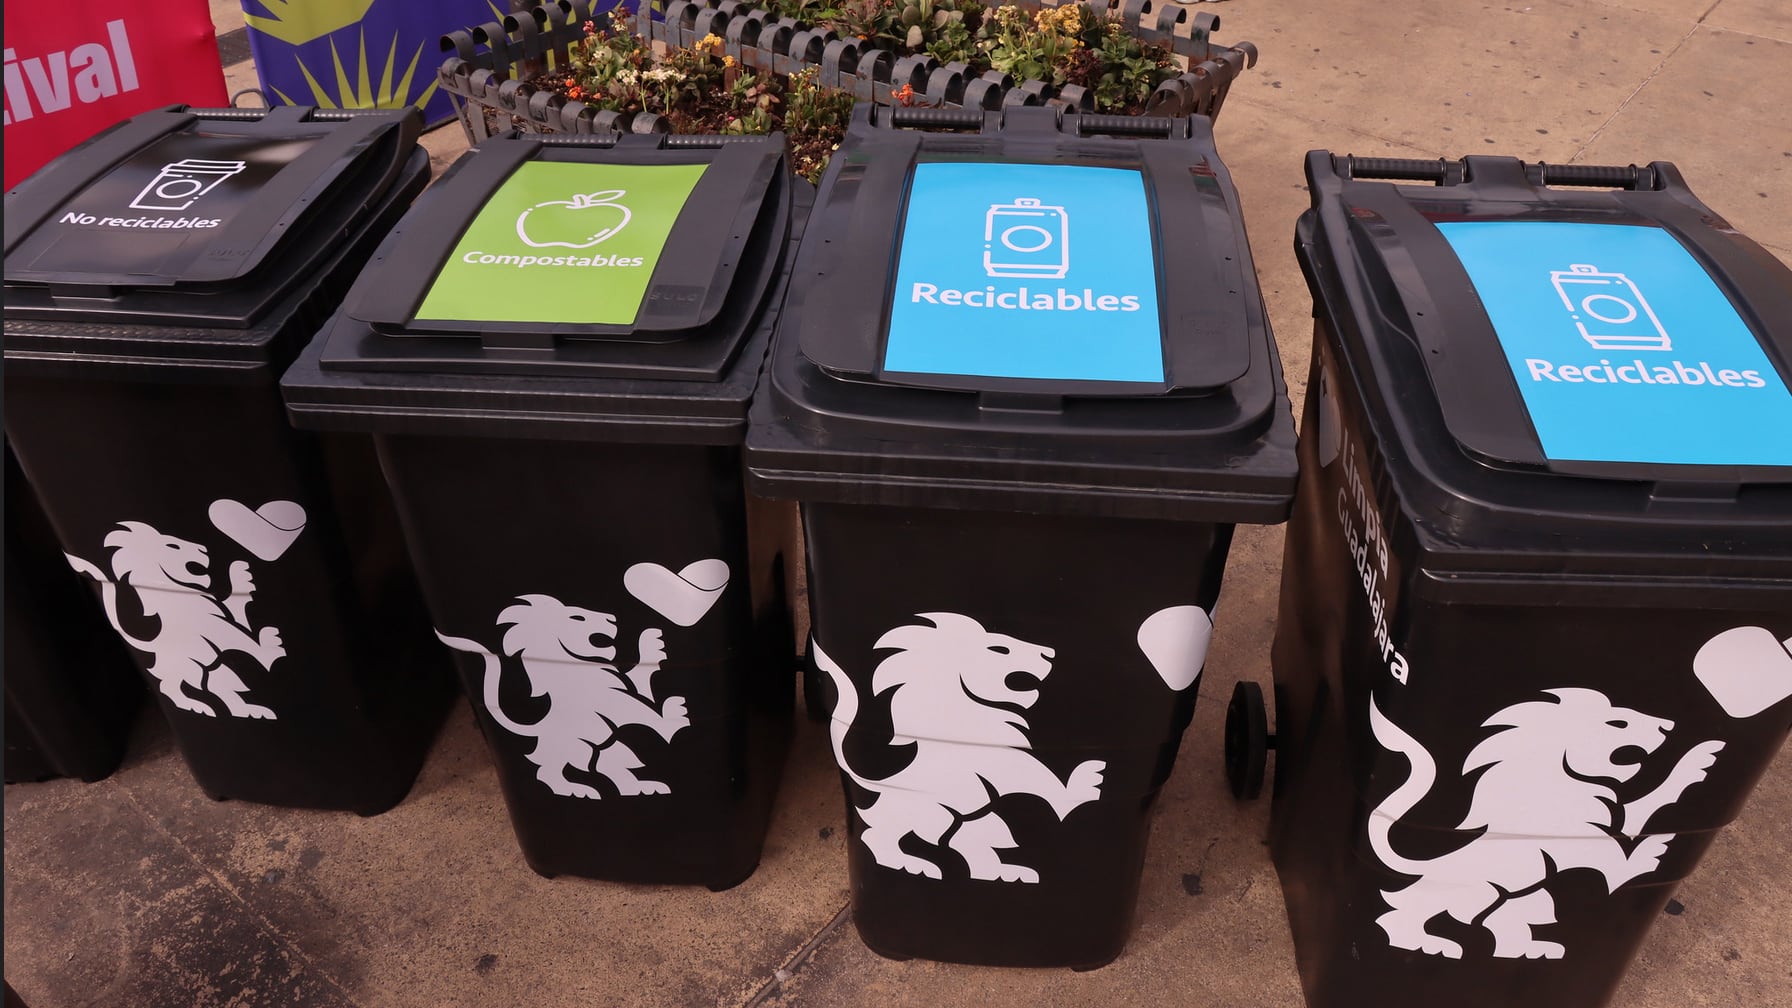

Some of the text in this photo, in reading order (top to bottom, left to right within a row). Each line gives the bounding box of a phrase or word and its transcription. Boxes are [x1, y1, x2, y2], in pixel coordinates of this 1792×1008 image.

[4, 19, 139, 126] ival
[59, 212, 222, 229] No reciclables
[463, 251, 644, 268] Compostables
[911, 282, 1141, 312] Reciclables
[1525, 358, 1766, 388] Reciclables
[1343, 427, 1389, 581] Limpia
[1337, 487, 1410, 686] Guadalajara
